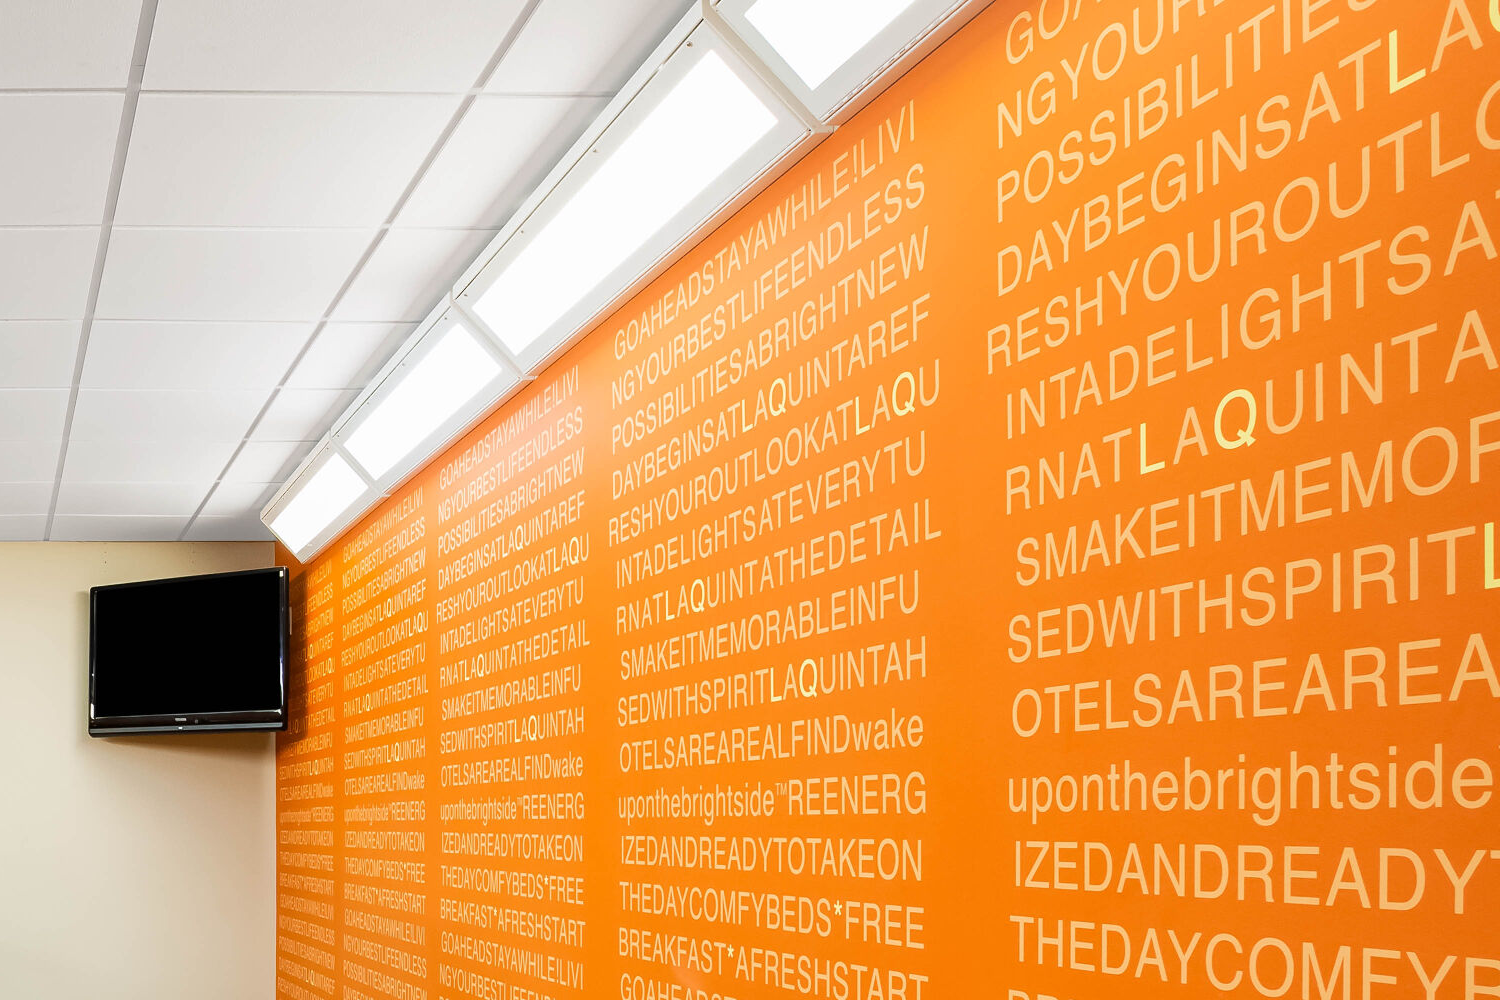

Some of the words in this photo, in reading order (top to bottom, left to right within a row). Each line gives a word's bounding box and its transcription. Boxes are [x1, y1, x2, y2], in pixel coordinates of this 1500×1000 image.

[998, 0, 1215, 149] NGYOU
[998, 0, 1380, 223] POSSIBILITIE
[998, 0, 1500, 297] DAYBEGINSATLA
[614, 100, 914, 359] GOAHEADSTAYAWHILE!LIVI
[612, 163, 925, 409] NGYOURBESTLIFEENDLESS
[612, 226, 928, 454] POSSIBILITIESABRIGHTNEW
[1007, 190, 1500, 440] INTADELIGHTSA
[440, 364, 579, 490] GOAHEADSTAYAWHILE!LIVI
[613, 293, 930, 499] DAYBEGINSATLAQUINTAREF
[438, 405, 583, 525] NGYOURBESTLIFEENDLESS
[438, 447, 584, 558] POSSIBILITIESABRIGHTNEW
[609, 359, 940, 547] RESHYOUROUTLOOKATLAQU
[438, 490, 585, 591] DAYBEGINSATLAQUINTAREF
[616, 430, 926, 588] INTADELIGHTSATEVERYTU
[436, 532, 589, 624] RESHYOUROUTLOOKATLAQU
[440, 575, 584, 655] INTADELIGHTSATEVERYTU
[617, 499, 941, 635] RNATLAQUINTATHEDETAIL
[440, 619, 590, 689] RNATLAQUINTATHEDETAIL
[620, 570, 919, 680] SMAKEITMEMORABLEINFU
[440, 707, 584, 754] SEDWITHSPIRITLAQUINTAH
[441, 663, 581, 721] SMAKEITMEMORABLEINFU
[618, 636, 926, 727] SEDWITHSPIRITLAQUINTAH
[441, 751, 583, 787] OTELSAREAREALFINDwake
[619, 708, 924, 772] OTELSAREAREALFINDwake
[441, 832, 583, 862] IZEDANDREADYTOTAKEON
[621, 836, 922, 881] IZEDANDREADYTOTAKEON
[1014, 841, 1500, 915] IZEDANDREADY
[441, 932, 583, 990] GOAHEADSTAYAWHILE!LIVI
